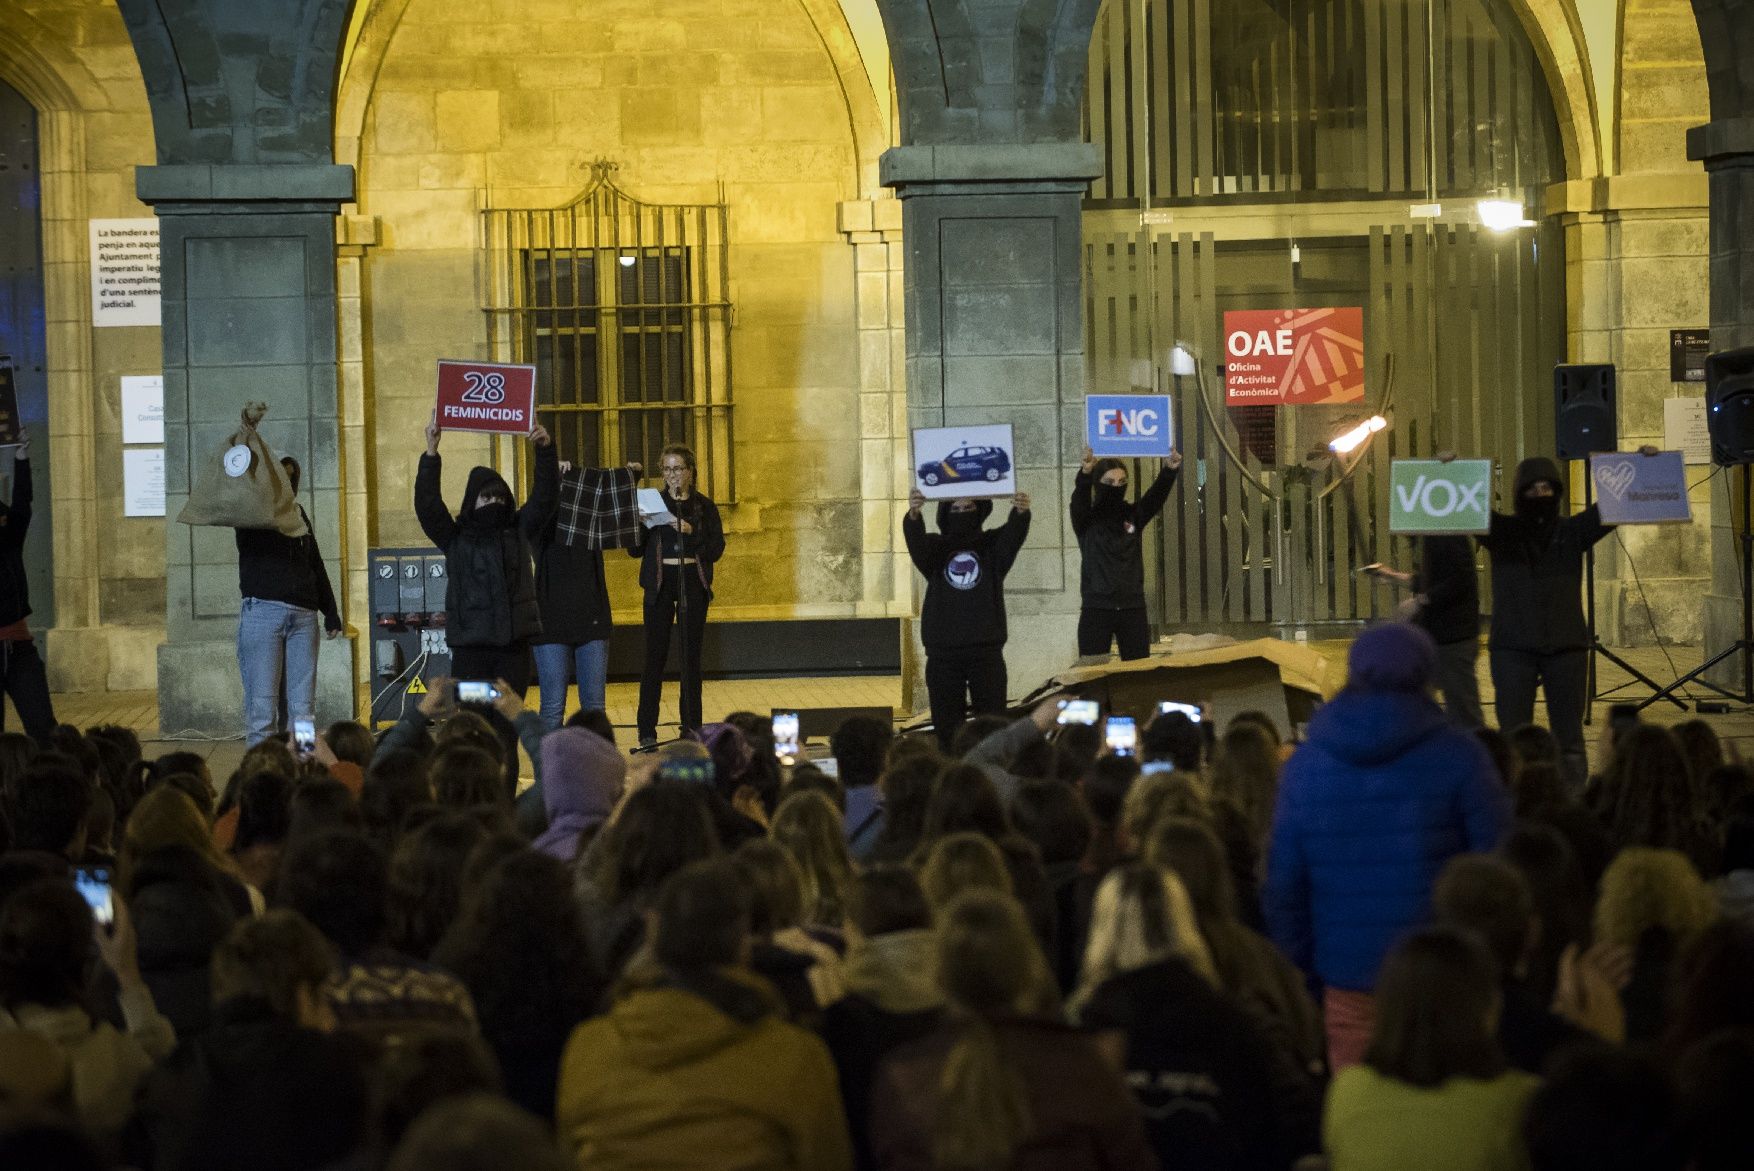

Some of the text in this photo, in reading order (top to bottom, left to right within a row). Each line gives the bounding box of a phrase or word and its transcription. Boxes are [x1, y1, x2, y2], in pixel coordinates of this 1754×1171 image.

[98, 229, 109, 237] La
[110, 229, 148, 237] bandera
[98, 242, 124, 251] penja
[100, 253, 153, 262] Ajuntament
[100, 265, 144, 273] imperatiu
[100, 288, 126, 297] d'una
[101, 300, 136, 310] judicial.
[1228, 329, 1294, 357] OAE
[1228, 362, 1262, 372] Oficina
[1229, 375, 1276, 385] d'Activitat
[462, 371, 505, 405] 28
[1229, 387, 1279, 397] Econòmica
[444, 405, 524, 422] FEMINICIDIS
[1396, 475, 1484, 517] VOX
